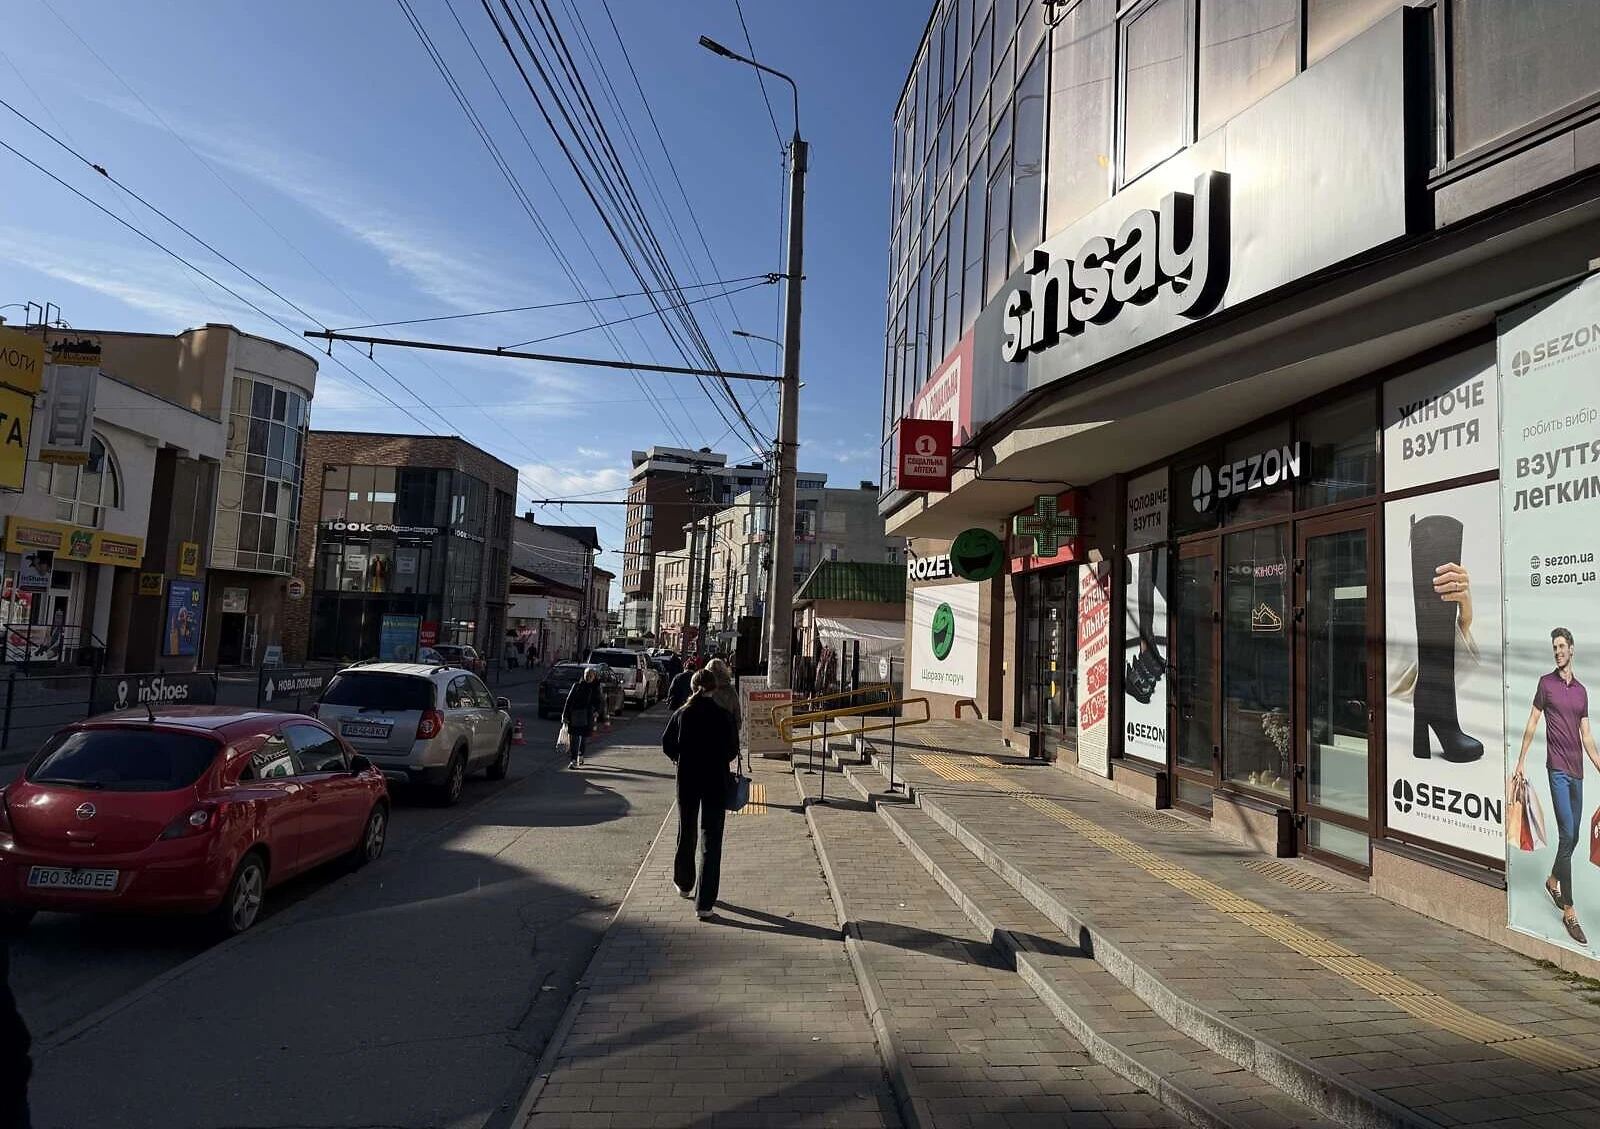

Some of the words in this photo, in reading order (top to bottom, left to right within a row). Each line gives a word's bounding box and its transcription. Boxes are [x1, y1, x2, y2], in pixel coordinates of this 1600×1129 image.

[1001, 171, 1228, 362] sinsay
[1398, 381, 1484, 429] ЖІНОЧЕ
[1522, 420, 1563, 441] робить
[1565, 408, 1597, 427] вибір
[922, 439, 931, 452] 1
[1402, 418, 1479, 460] ВЗУТТЯ
[908, 457, 944, 466] СОЦІАЛЬНА
[913, 466, 937, 474] АПТЕКА
[1218, 441, 1300, 498] SEZON
[1129, 488, 1167, 513] ЧОЛОВІЧЕ
[1133, 511, 1161, 531] ВЗУТТЯ
[908, 554, 954, 580] ROZET
[1544, 552, 1594, 567] sezon.ua
[1544, 571, 1596, 586] sezon_ua
[278, 679, 295, 691] НОВА
[921, 667, 944, 684] Щоразу
[945, 672, 964, 687] поруч
[138, 677, 188, 702] inShoes
[1135, 723, 1165, 743] SEZON
[1416, 783, 1502, 824] SEZON
[40, 871, 59, 884] BO
[95, 873, 114, 887] EE
